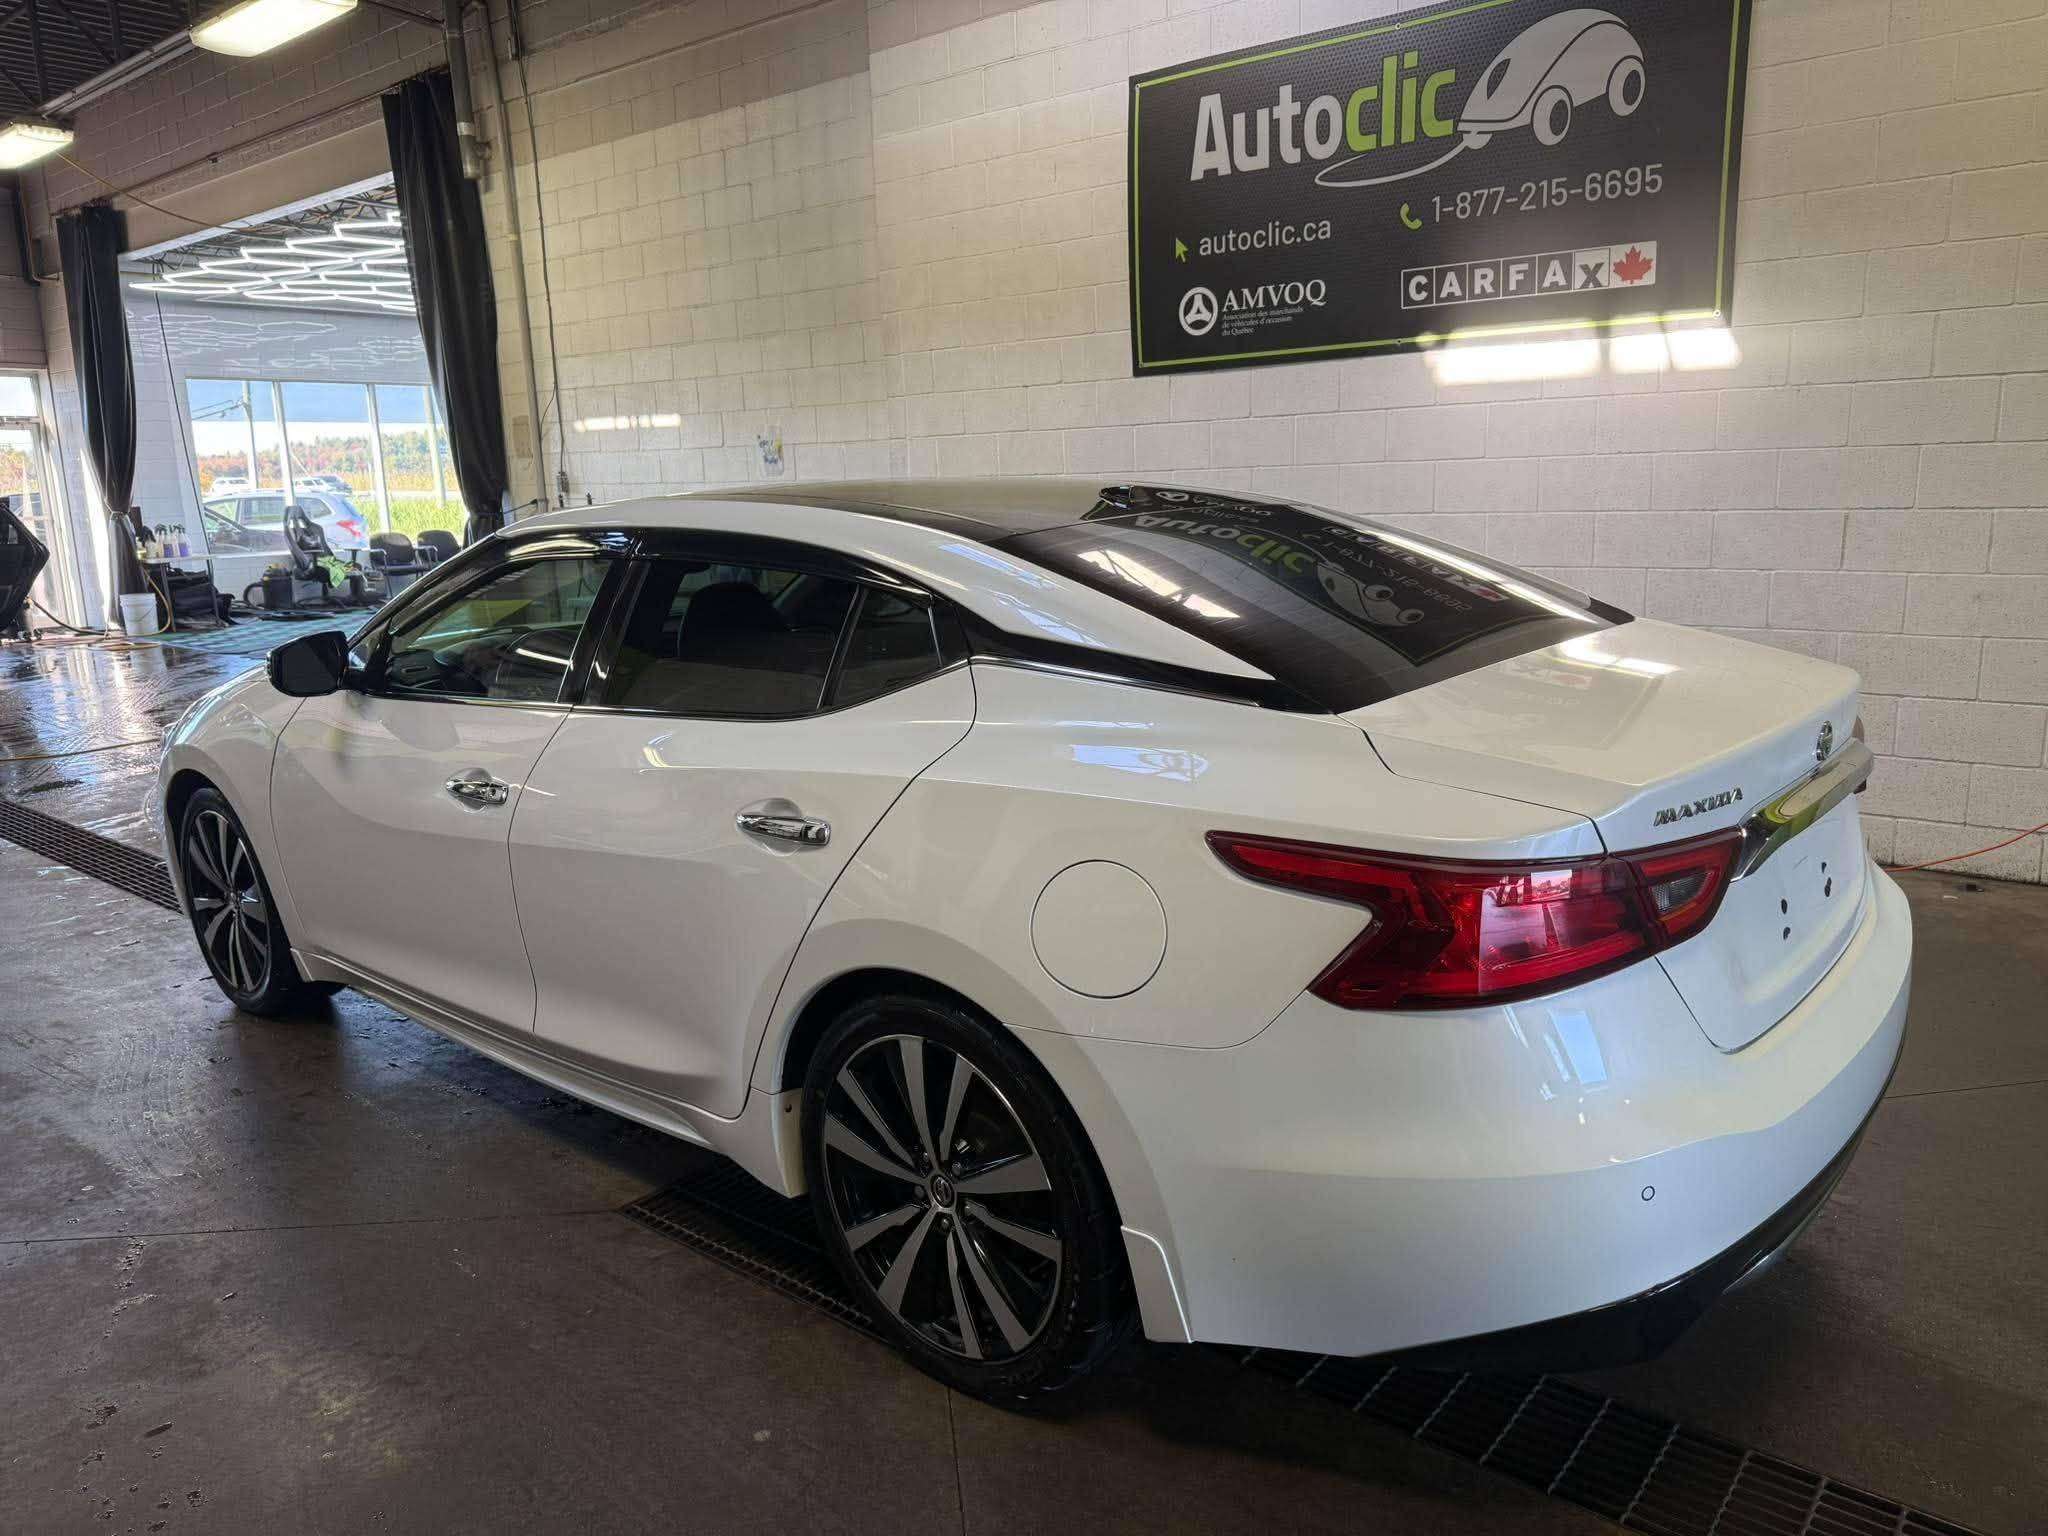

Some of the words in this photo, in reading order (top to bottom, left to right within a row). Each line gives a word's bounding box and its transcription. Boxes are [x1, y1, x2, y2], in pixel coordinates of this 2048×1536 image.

[1190, 51, 1456, 182] Autoclic
[1431, 163, 1663, 223] 1-877-215-6695
[1199, 219, 1332, 257] autoclic.ca
[1222, 279, 1327, 312] AMVOQ
[1408, 258, 1605, 302] CARFAX
[1653, 786, 1743, 827] MAXIMA
